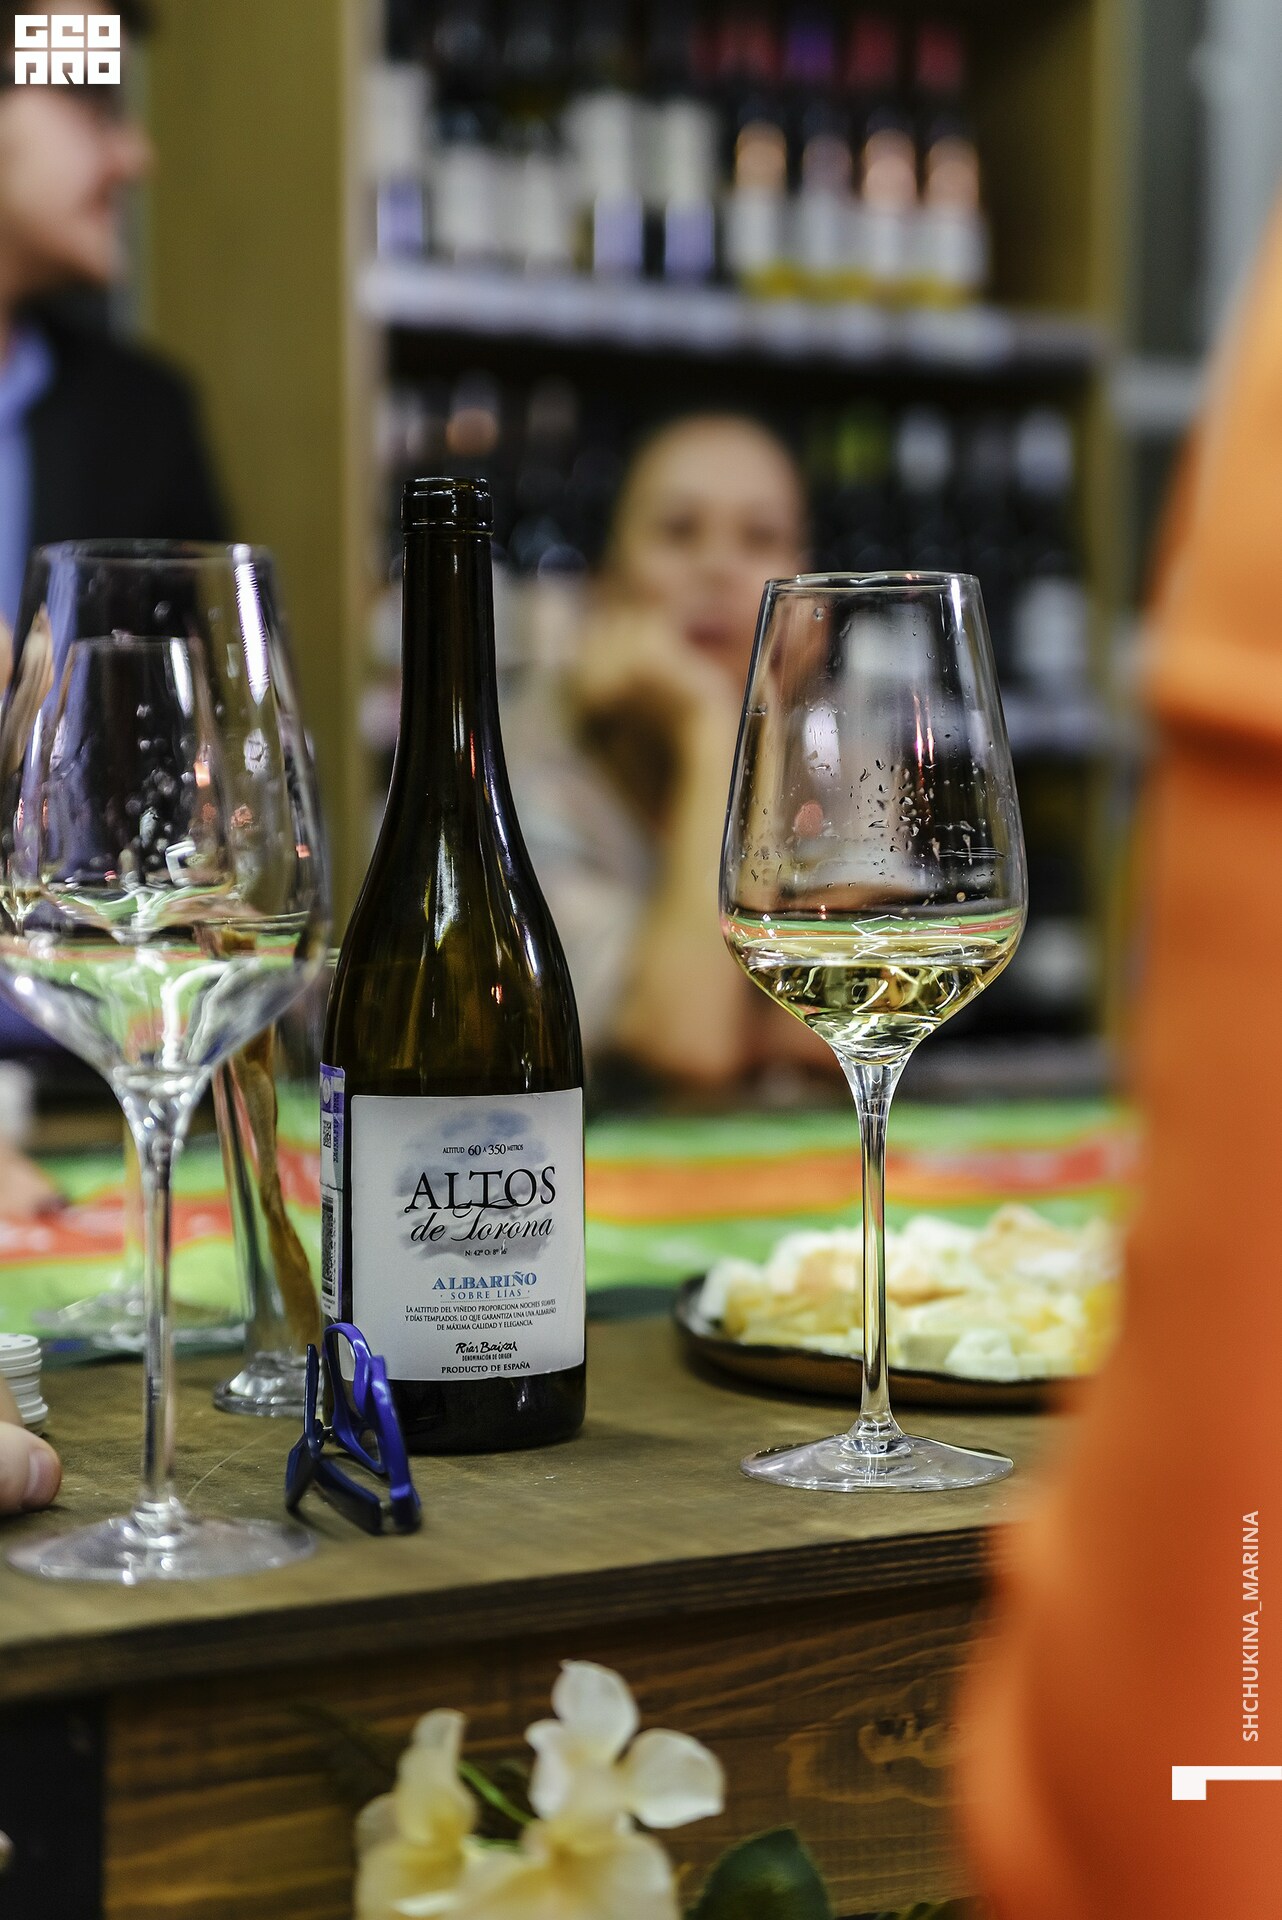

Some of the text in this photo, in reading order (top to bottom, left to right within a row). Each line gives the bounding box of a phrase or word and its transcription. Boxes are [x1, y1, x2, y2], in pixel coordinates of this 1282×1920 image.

[443, 1146, 465, 1154] ALTITUD
[468, 1144, 482, 1156] 60
[488, 1143, 506, 1155] 350
[507, 1143, 524, 1151] METROS
[404, 1166, 556, 1213] ALTOS
[410, 1199, 554, 1242] de Torona
[432, 1271, 537, 1290] ALBARIÑO
[450, 1288, 522, 1300] SOBRE LÍAS
[415, 1305, 439, 1313] ALTITUD
[441, 1305, 451, 1313] DEL
[453, 1304, 477, 1313] VIÑEDO
[478, 1303, 519, 1312] PROPORCIONA
[520, 1301, 540, 1309] NOCHES
[409, 1313, 423, 1322] DÍAS
[469, 1313, 481, 1322] QUE
[482, 1312, 513, 1321] GARANTIZA
[513, 1311, 524, 1319] UNA
[436, 1323, 445, 1331] DE
[446, 1322, 471, 1331] MÁXIMA
[472, 1321, 498, 1330] CALIDAD
[498, 1321, 503, 1329] Y
[455, 1341, 479, 1354] Rías
[441, 1361, 531, 1374] PRODUCTO DE ESPAÑA
